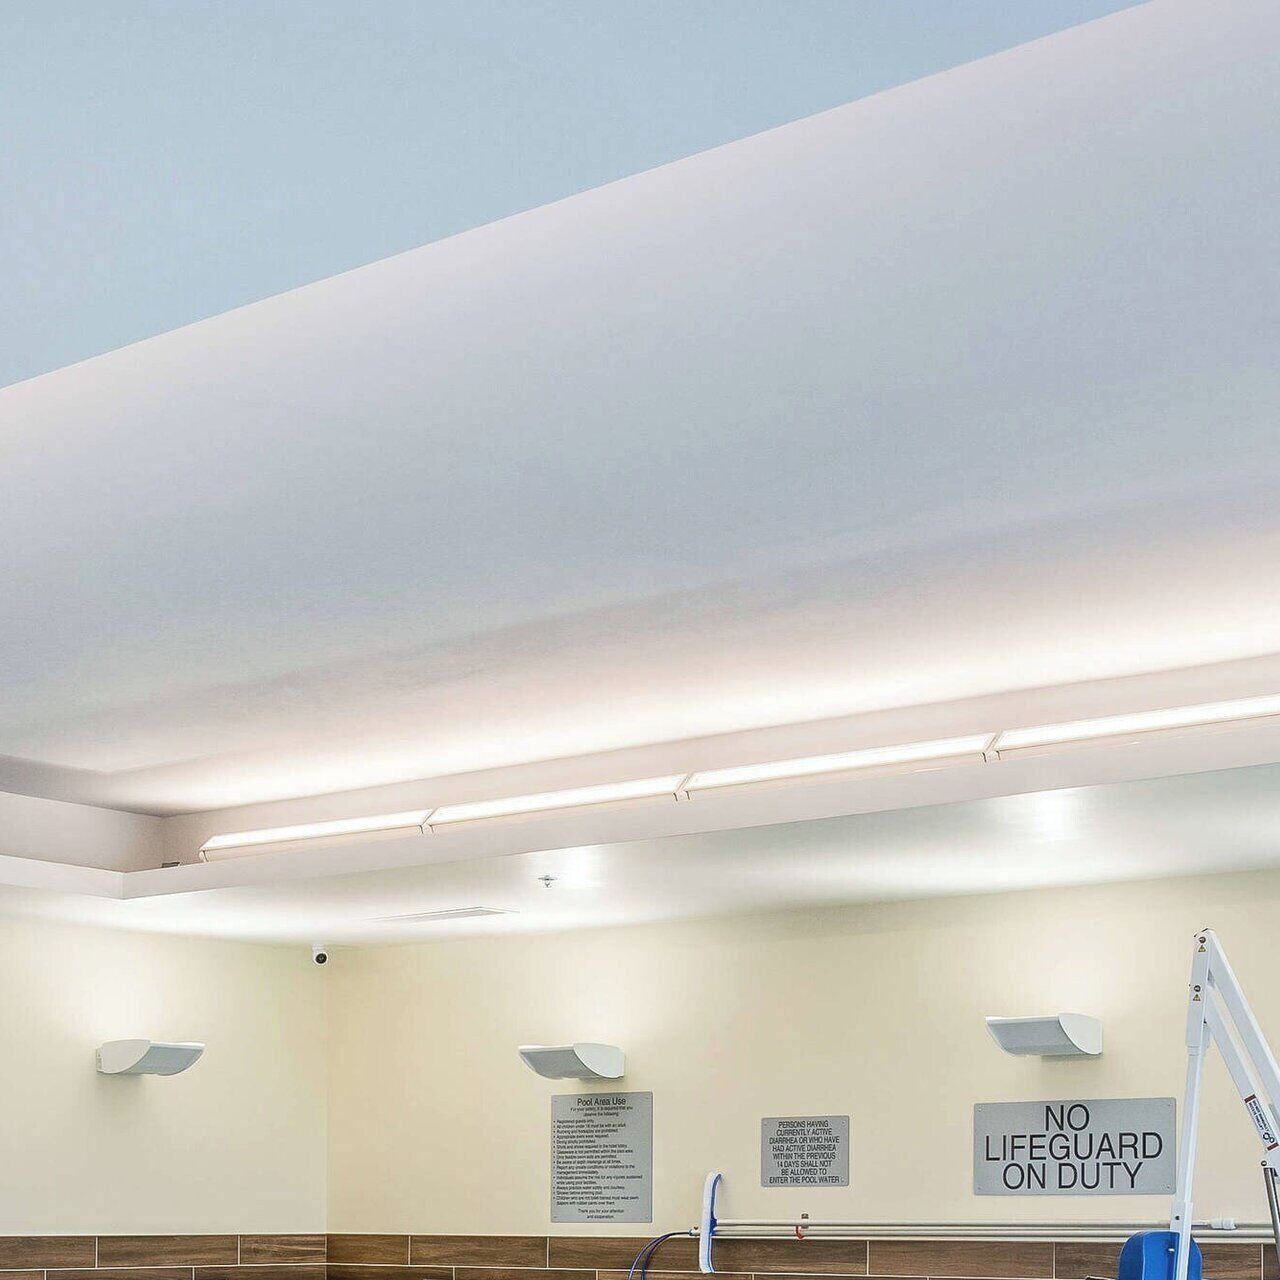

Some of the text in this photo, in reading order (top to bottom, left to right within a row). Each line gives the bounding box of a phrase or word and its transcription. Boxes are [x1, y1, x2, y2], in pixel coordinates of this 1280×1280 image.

[577, 1097, 626, 1106] Pool Area Use
[1045, 1103, 1090, 1131] NO
[807, 1120, 828, 1128] HAVING
[769, 1137, 798, 1145] DIARRHEA
[807, 1144, 837, 1152] DIARRHEA
[985, 1132, 1163, 1161] LIFEGUARD
[806, 1152, 836, 1160] PREVIOUS
[769, 1176, 788, 1184] ENTER
[818, 1175, 840, 1183] WATER
[1002, 1161, 1144, 1190] ON DUTY
